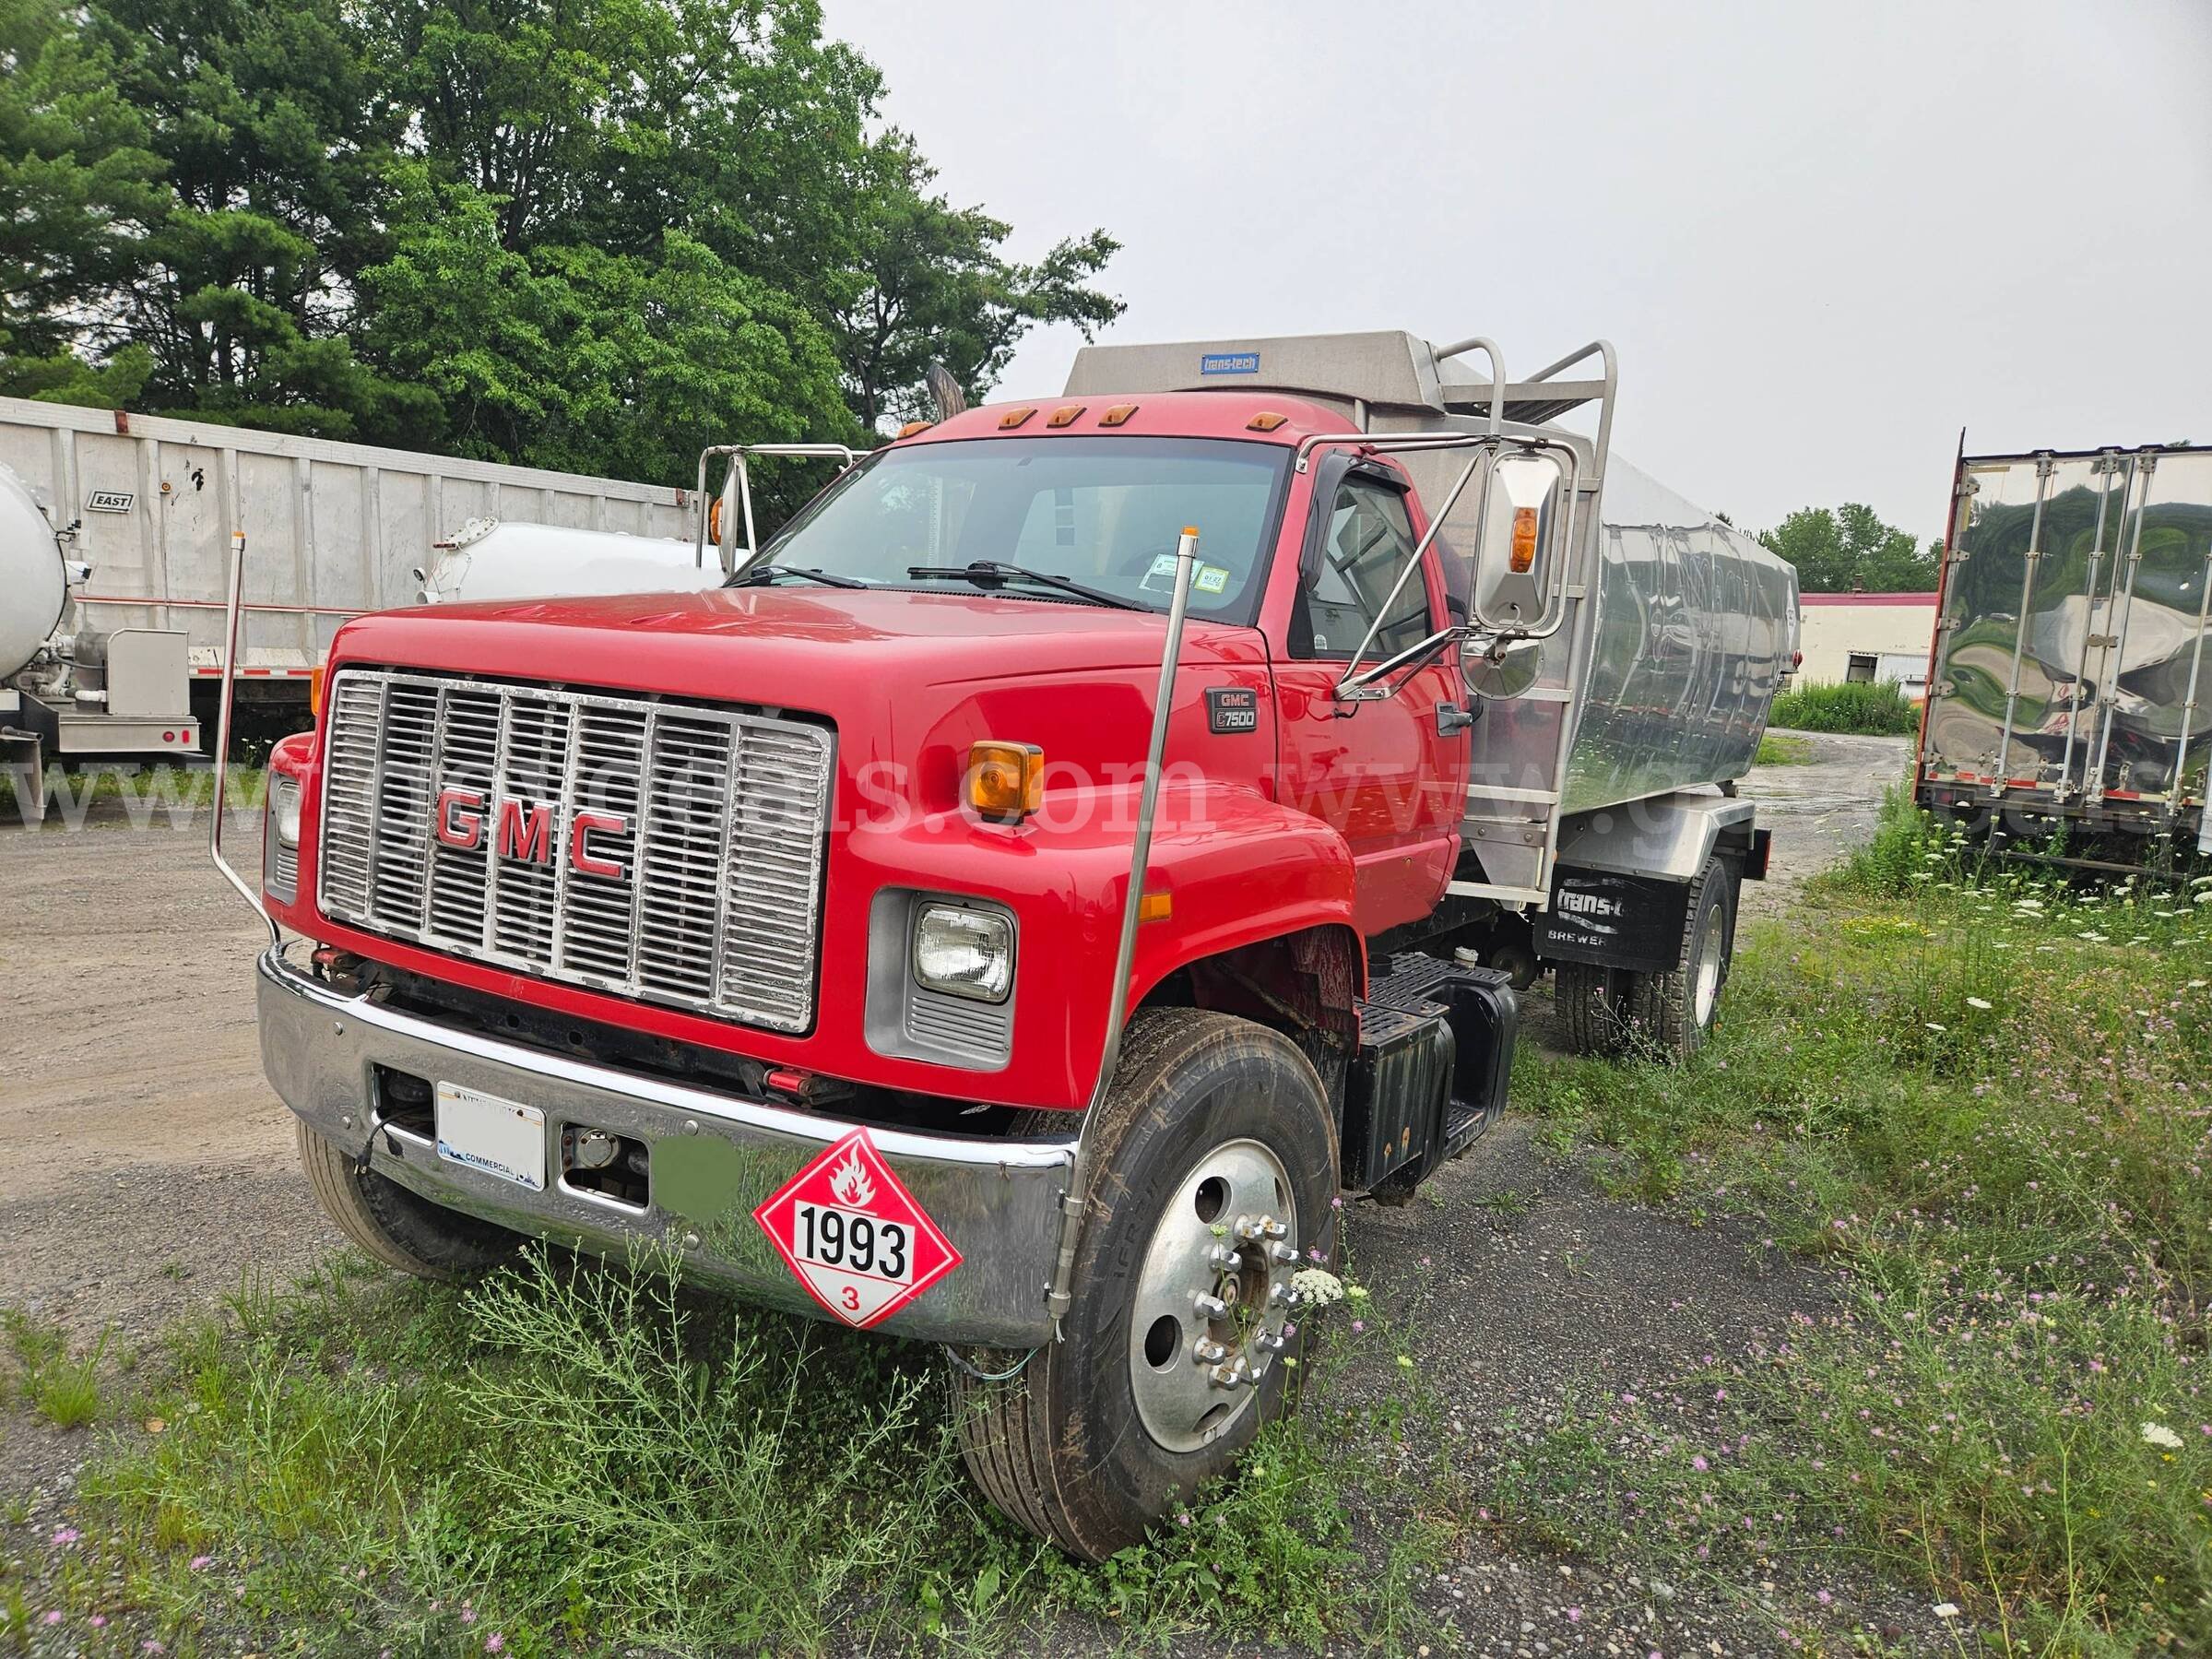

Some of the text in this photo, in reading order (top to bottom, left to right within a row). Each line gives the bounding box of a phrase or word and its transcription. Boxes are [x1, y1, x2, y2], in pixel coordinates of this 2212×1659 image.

[96, 495, 128, 506] EAST
[1221, 693, 1249, 706] GMC
[1216, 711, 1255, 727] C7500
[437, 786, 630, 881] GMC
[1547, 929, 1606, 946] BREWER
[466, 1153, 515, 1176] COMMERCIAL
[800, 1206, 905, 1278] 1993
[841, 1286, 860, 1311] 3
